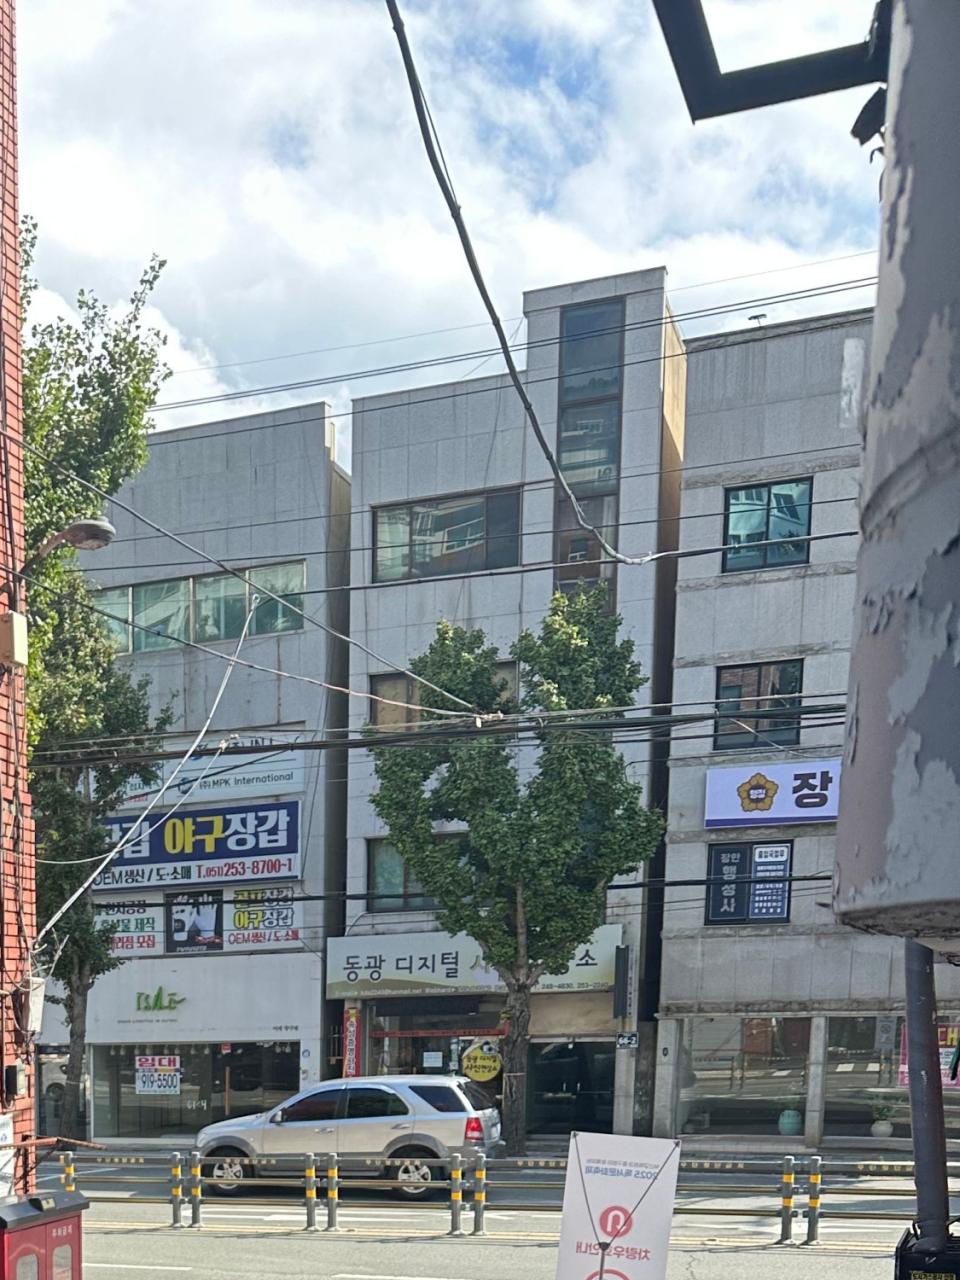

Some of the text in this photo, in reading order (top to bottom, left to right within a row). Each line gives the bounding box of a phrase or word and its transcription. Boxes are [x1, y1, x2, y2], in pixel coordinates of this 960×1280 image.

[234, 772, 294, 786] International
[164, 809, 290, 854] 야구장갑
[343, 954, 386, 982] 동광
[395, 950, 459, 979] 디지털
[138, 1057, 177, 1067] 임대
